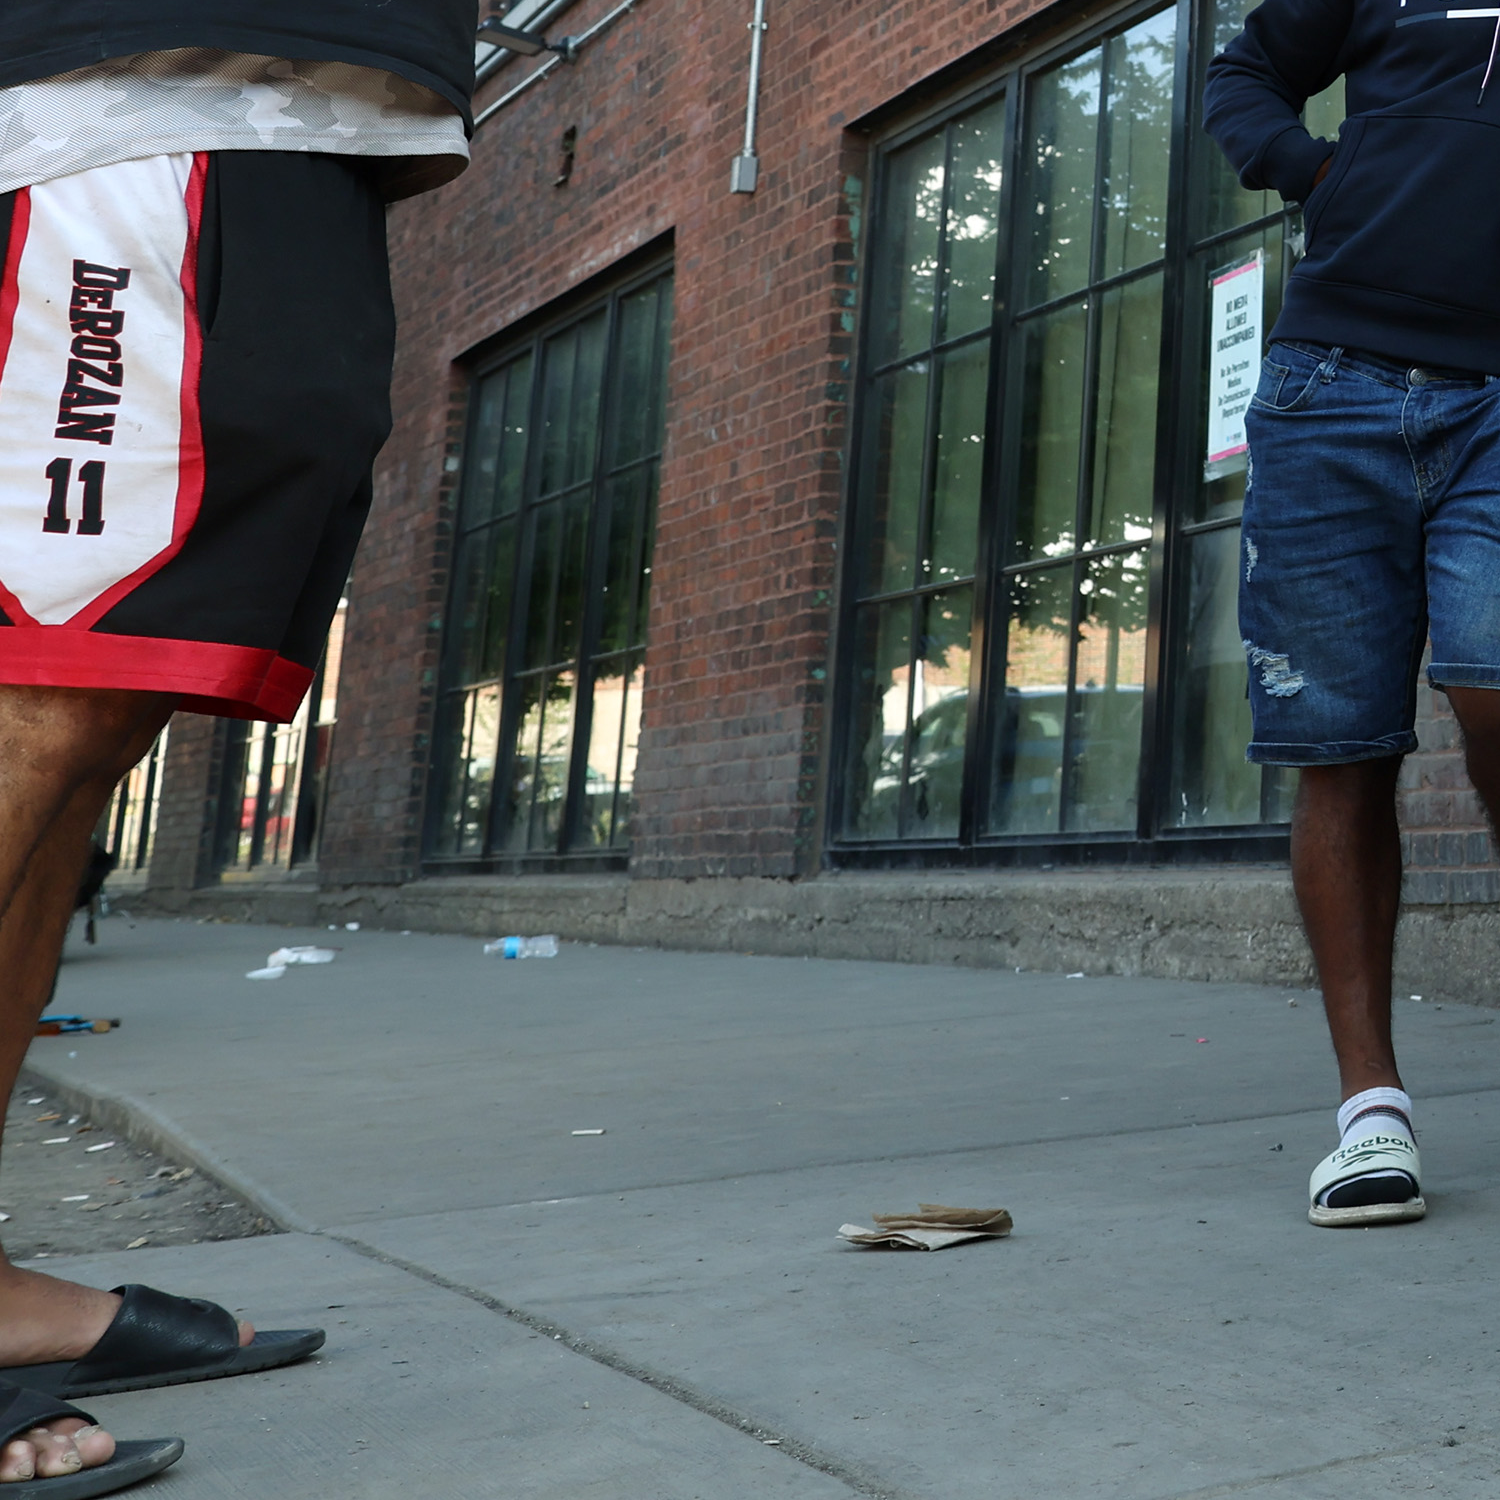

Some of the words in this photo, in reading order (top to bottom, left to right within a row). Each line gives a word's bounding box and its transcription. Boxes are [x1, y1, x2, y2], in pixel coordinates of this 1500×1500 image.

[54, 259, 131, 446] DEROZAN
[42, 457, 106, 536] 11
[1331, 1136, 1414, 1164] Reebok
